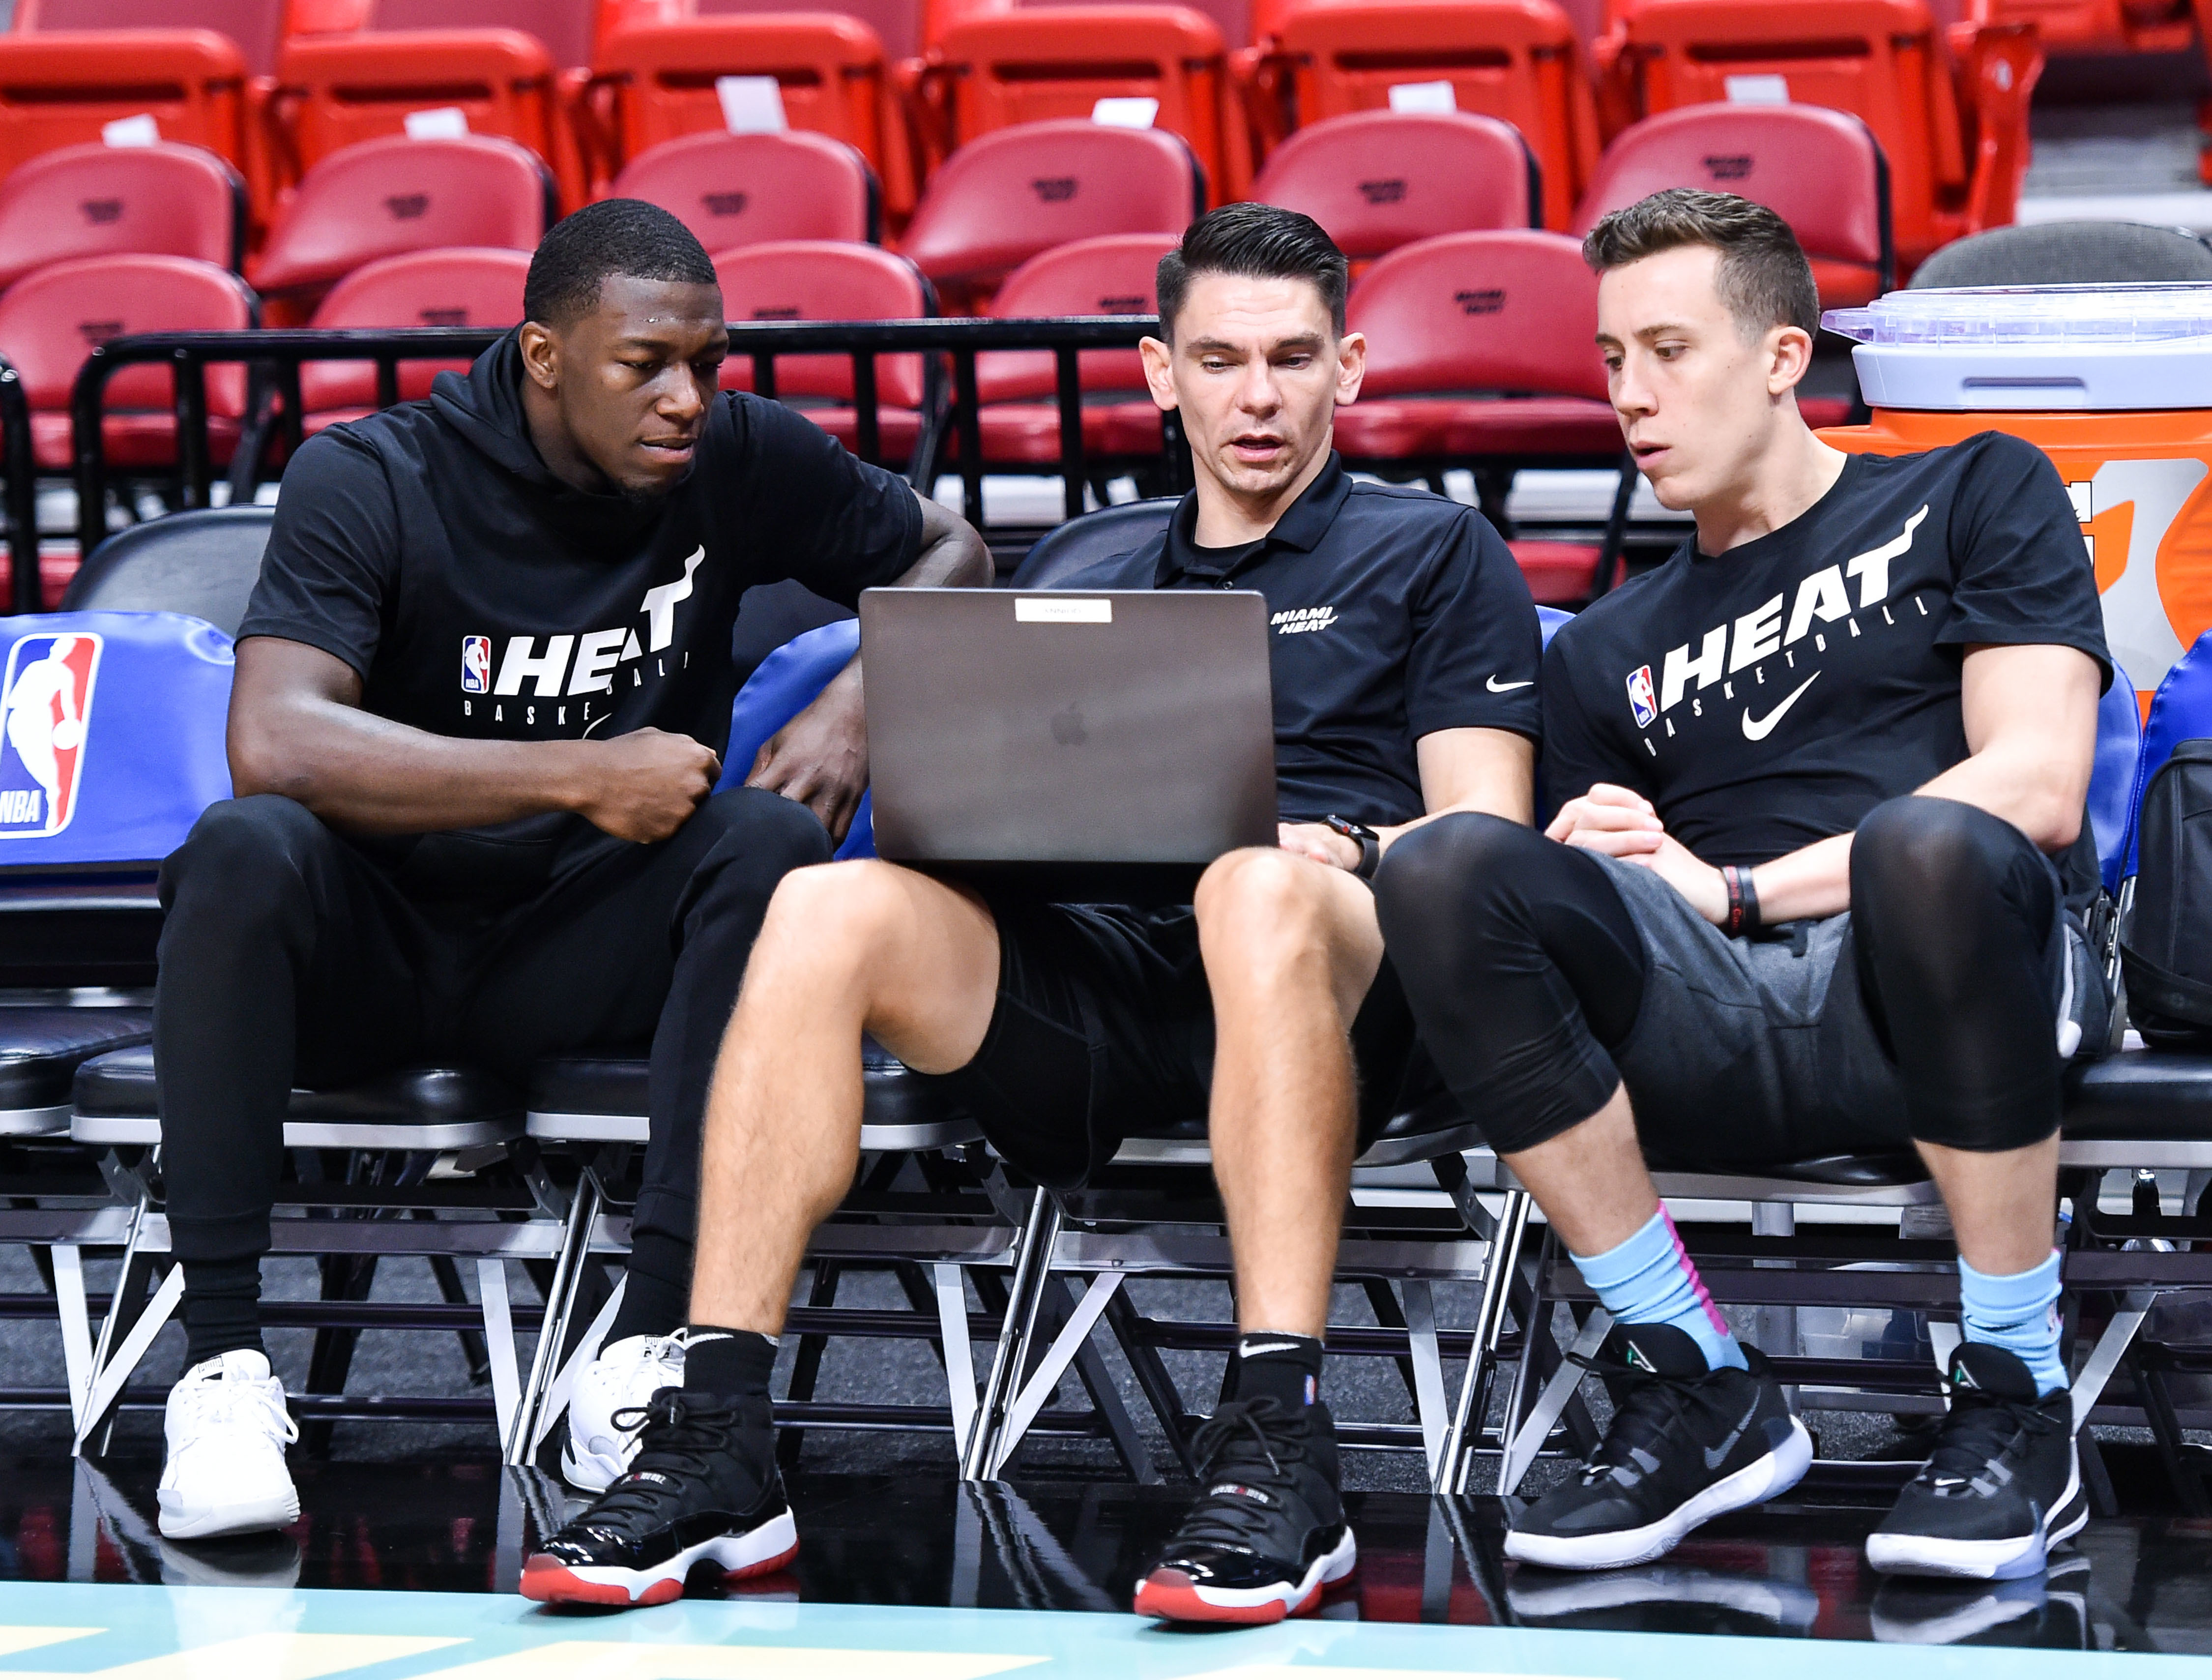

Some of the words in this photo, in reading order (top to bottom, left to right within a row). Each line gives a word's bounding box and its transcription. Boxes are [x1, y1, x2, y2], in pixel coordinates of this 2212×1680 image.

[1270, 606, 1333, 624] MIAMI
[1279, 616, 1339, 634] HEAT
[1661, 504, 1929, 712] HEAT
[1644, 596, 1928, 756] BASKETBALL
[0, 790, 42, 824] NBA
